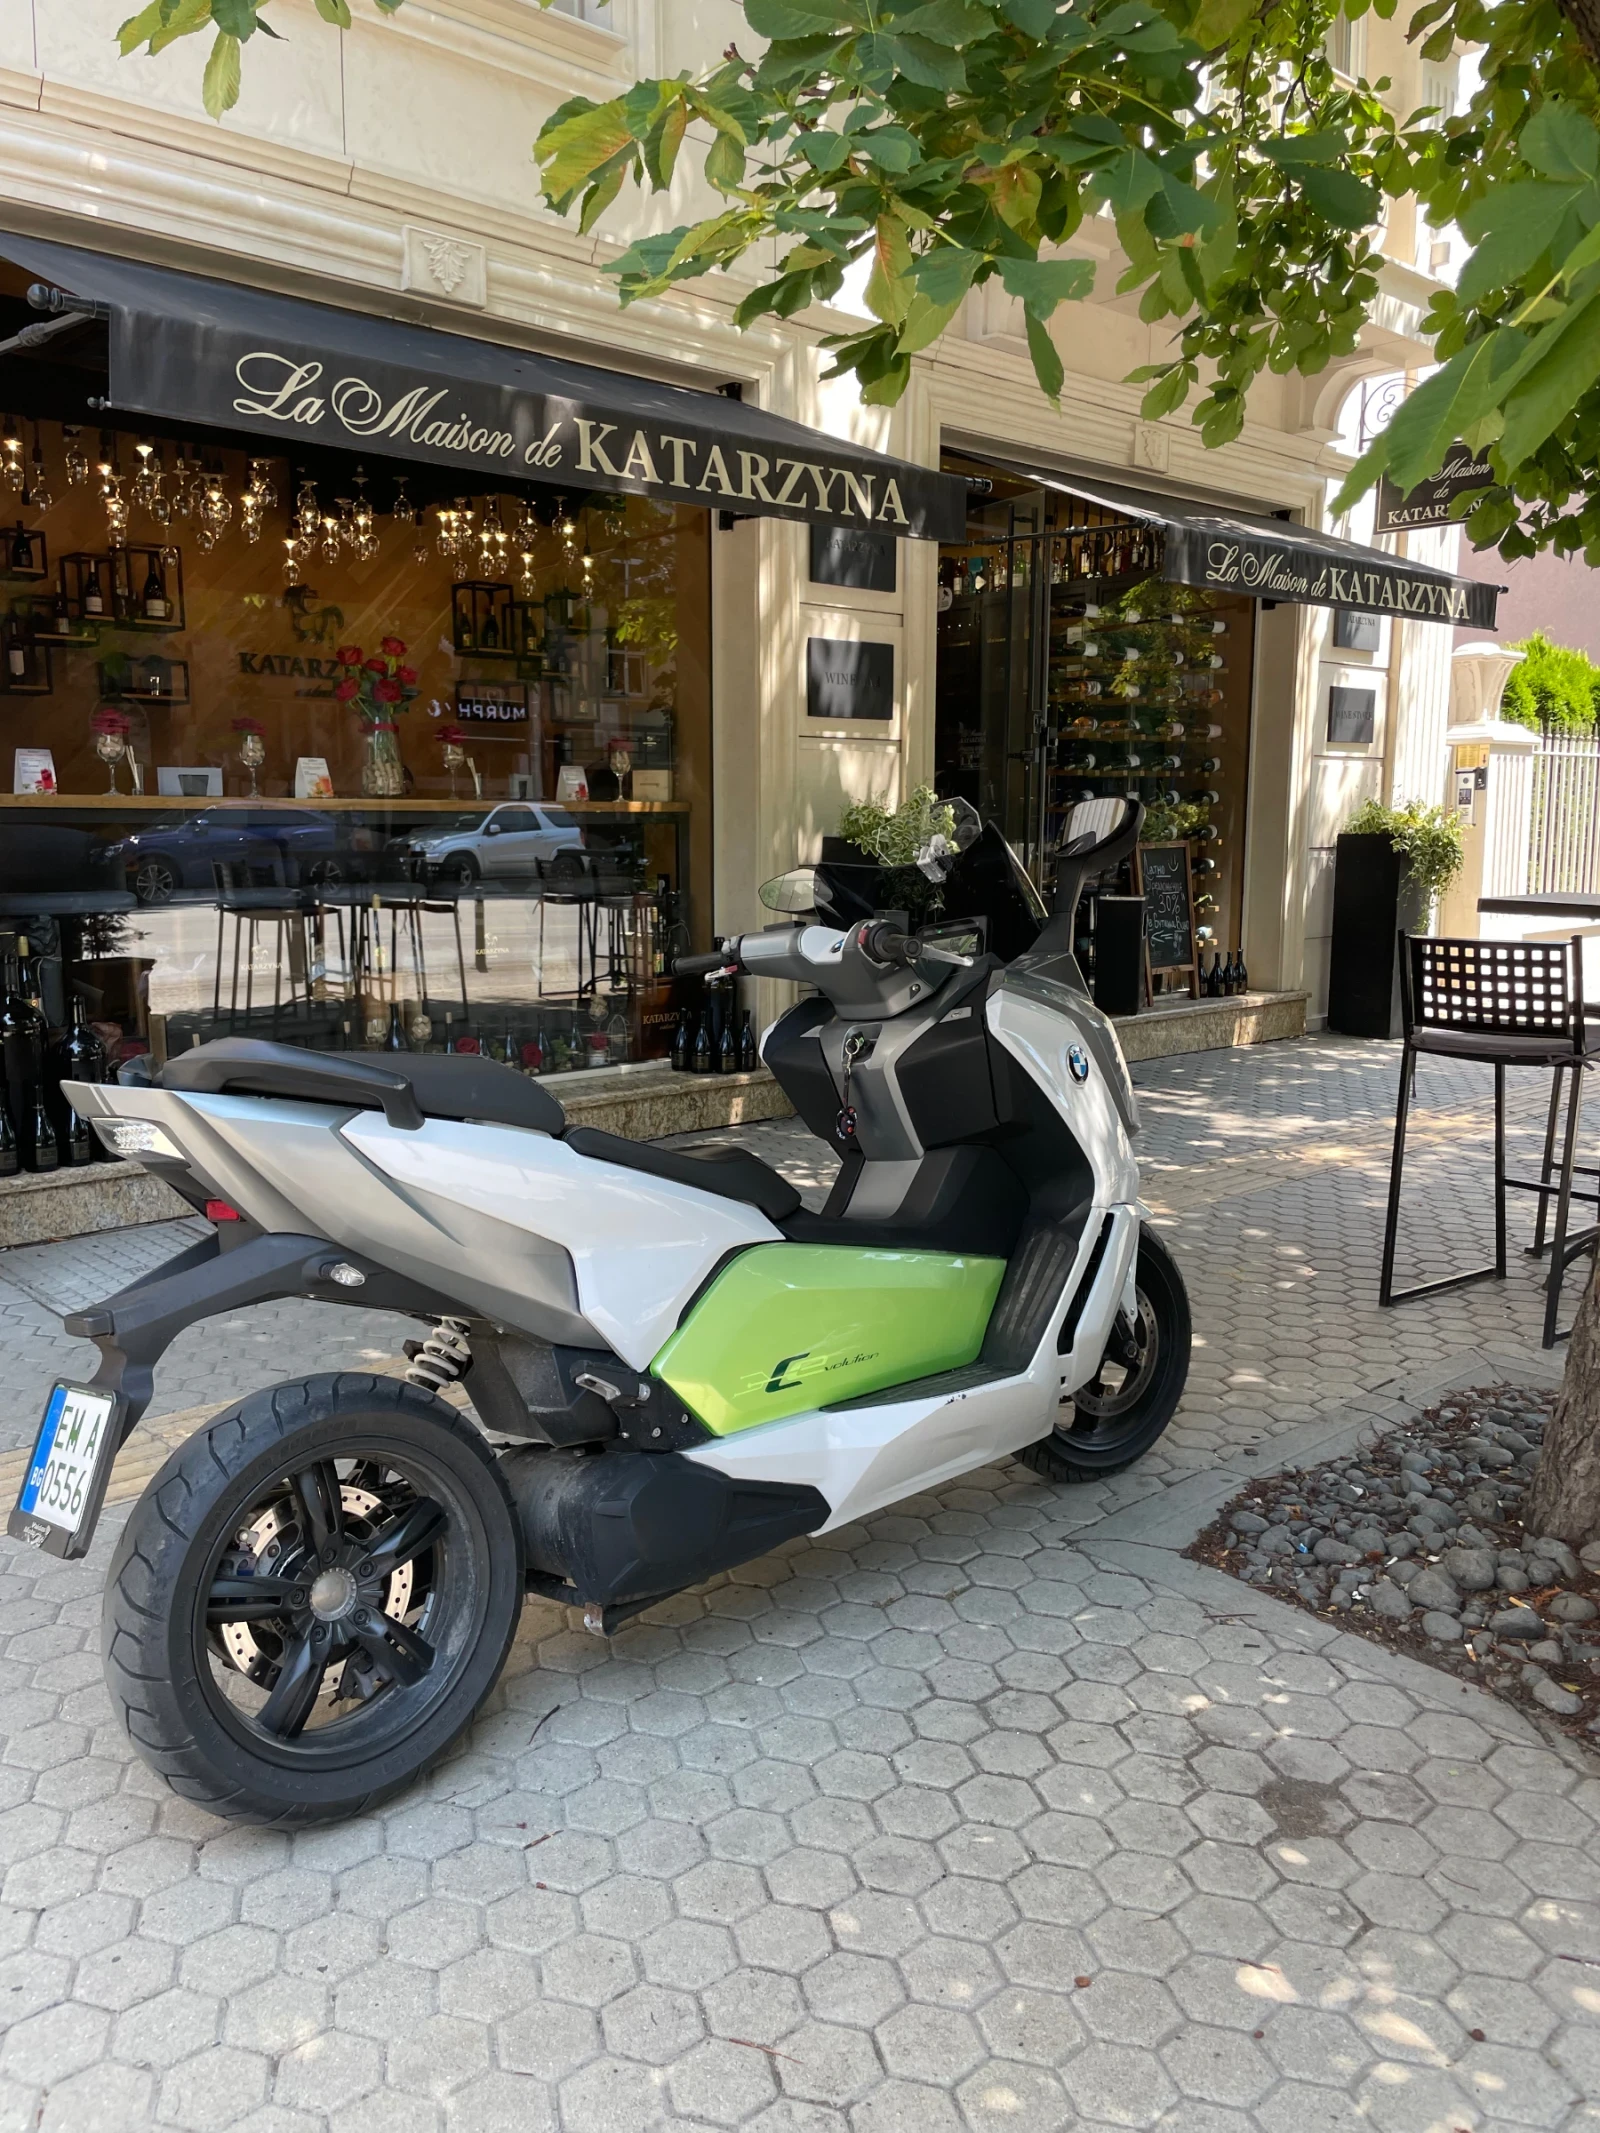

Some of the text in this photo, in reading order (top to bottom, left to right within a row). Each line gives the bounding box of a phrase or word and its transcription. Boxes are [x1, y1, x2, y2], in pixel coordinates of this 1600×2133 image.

[232, 352, 910, 526] La Maison de KATARZYNA
[1428, 456, 1492, 482] Maison
[1433, 480, 1450, 499] de
[1387, 498, 1484, 525] KATARN
[1206, 542, 1470, 620] La Maison de KATARZYNA
[238, 651, 341, 680] KATARZ
[825, 672, 857, 686] WINE
[643, 1010, 692, 1025] KATARZYA
[30, 1466, 44, 1488] BG
[40, 1459, 87, 1516] 0556
